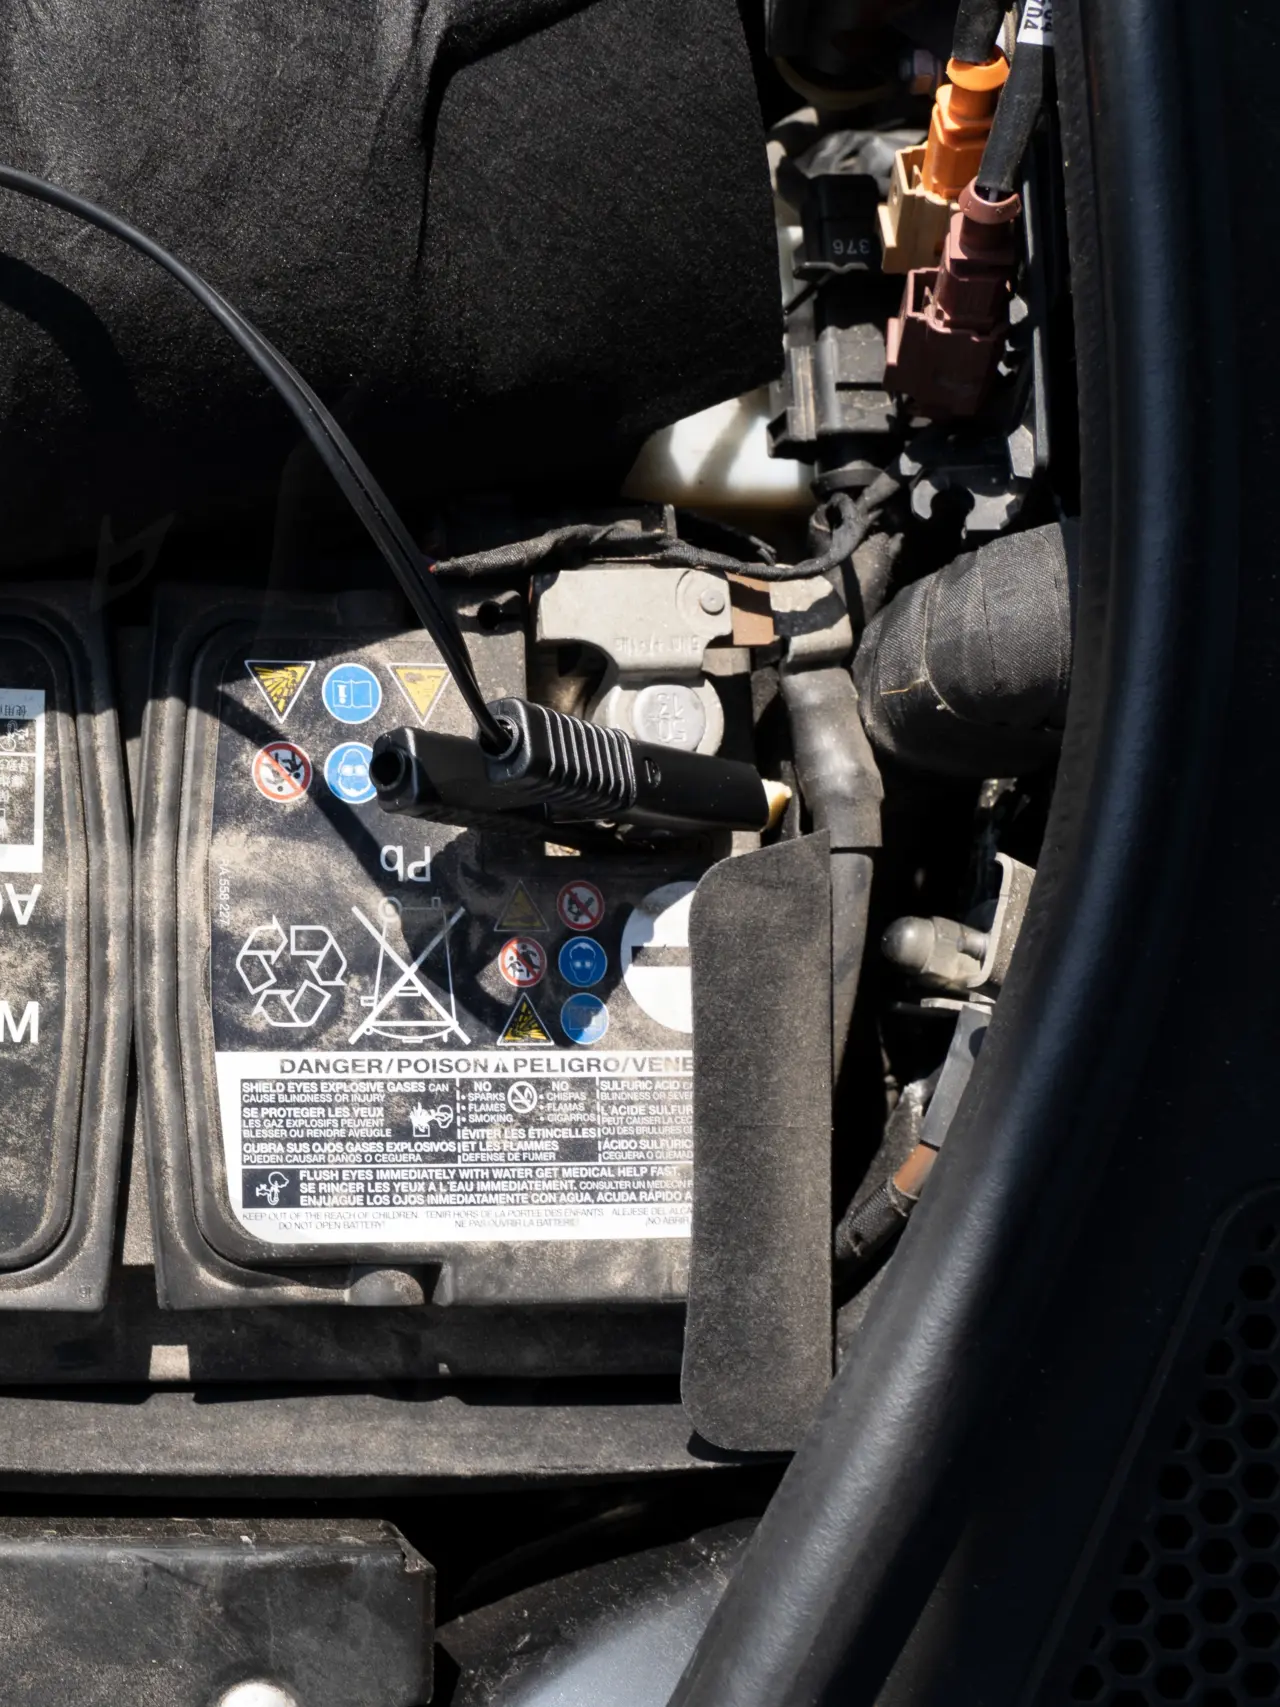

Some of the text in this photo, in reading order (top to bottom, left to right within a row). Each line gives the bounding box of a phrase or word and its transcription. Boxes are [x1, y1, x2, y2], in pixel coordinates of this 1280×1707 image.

[832, 238, 870, 255] 376
[381, 845, 432, 882] Pb
[219, 879, 230, 900] 558
[220, 904, 230, 925] 227
[242, 1082, 449, 1093] SHIELD EYES EXPLOSIVE GASES CAN
[474, 1081, 491, 1092] NO
[552, 1081, 569, 1091] NO
[600, 1080, 680, 1091] SULFURIC ACID
[243, 1094, 385, 1103] CAUSE BLINDNESS OR INJURY
[468, 1092, 505, 1101] SPARKS
[546, 1092, 586, 1101] CHISPAS
[601, 1092, 666, 1101] BLINDNESS OR
[243, 1107, 384, 1118] SE PROTEGER LES YEUX
[469, 1103, 506, 1112] FLAMES
[548, 1103, 585, 1112] FLAMAS
[469, 1114, 513, 1123] SMOKING
[548, 1113, 596, 1122] CIGARROS
[602, 1116, 624, 1125] PEUT
[626, 1116, 661, 1125] CAUSER
[663, 1116, 675, 1125] LA
[243, 1119, 384, 1128] LES GAZ EXPLOSIFS PEUVENT
[243, 1128, 391, 1138] BLESSER OU RENDRE AVEUGLE
[505, 1128, 526, 1139] LES
[602, 1127, 615, 1135] OU
[617, 1127, 633, 1135] DES
[287, 1142, 309, 1153] SUS
[312, 1142, 343, 1153] OJOS
[346, 1142, 383, 1153] GASES
[387, 1142, 456, 1152] EXPLOSIVOS
[462, 1141, 559, 1151] ET LES FLAMMES
[243, 1154, 283, 1164] PUEDEN
[286, 1154, 325, 1164] CAUSAR
[364, 1154, 372, 1163] O
[375, 1154, 422, 1163] CEGUERA
[508, 1153, 520, 1163] DE
[523, 1152, 556, 1162] FUMER
[602, 1152, 645, 1161] CEGUERA
[300, 1166, 680, 1180] FLUSH EYES IMMEDIATELY WITH WATER GET MEDICAL HELP FAST.
[300, 1183, 315, 1194] SE
[319, 1183, 364, 1193] RINCER
[368, 1182, 389, 1193] LES
[393, 1182, 425, 1193] YEUX
[440, 1181, 473, 1192] L'EAU
[580, 1181, 630, 1190] CONSULTER
[632, 1181, 645, 1190] UN
[300, 1195, 364, 1206] ENJUAGUE
[367, 1195, 389, 1206] LOS
[393, 1195, 424, 1206] OJOS
[427, 1193, 528, 1205] INMEDIATAMENTE
[531, 1193, 557, 1203] CON
[560, 1192, 594, 1204] AGUA,
[597, 1191, 637, 1202] ACUDA
[243, 1211, 266, 1220] KEEP
[269, 1211, 287, 1220] OUT
[290, 1211, 302, 1220] OF
[305, 1211, 321, 1220] THE
[325, 1210, 356, 1220] REACH
[358, 1210, 370, 1219] OF
[426, 1210, 451, 1219] TENIR
[453, 1209, 478, 1218] HORS
[494, 1209, 506, 1218] LA
[545, 1208, 562, 1217] DES
[565, 1208, 604, 1217] ENFANTS
[279, 1221, 292, 1230] DO
[295, 1221, 313, 1230] NOT
[316, 1220, 341, 1230] OPEN
[455, 1219, 467, 1228] NE
